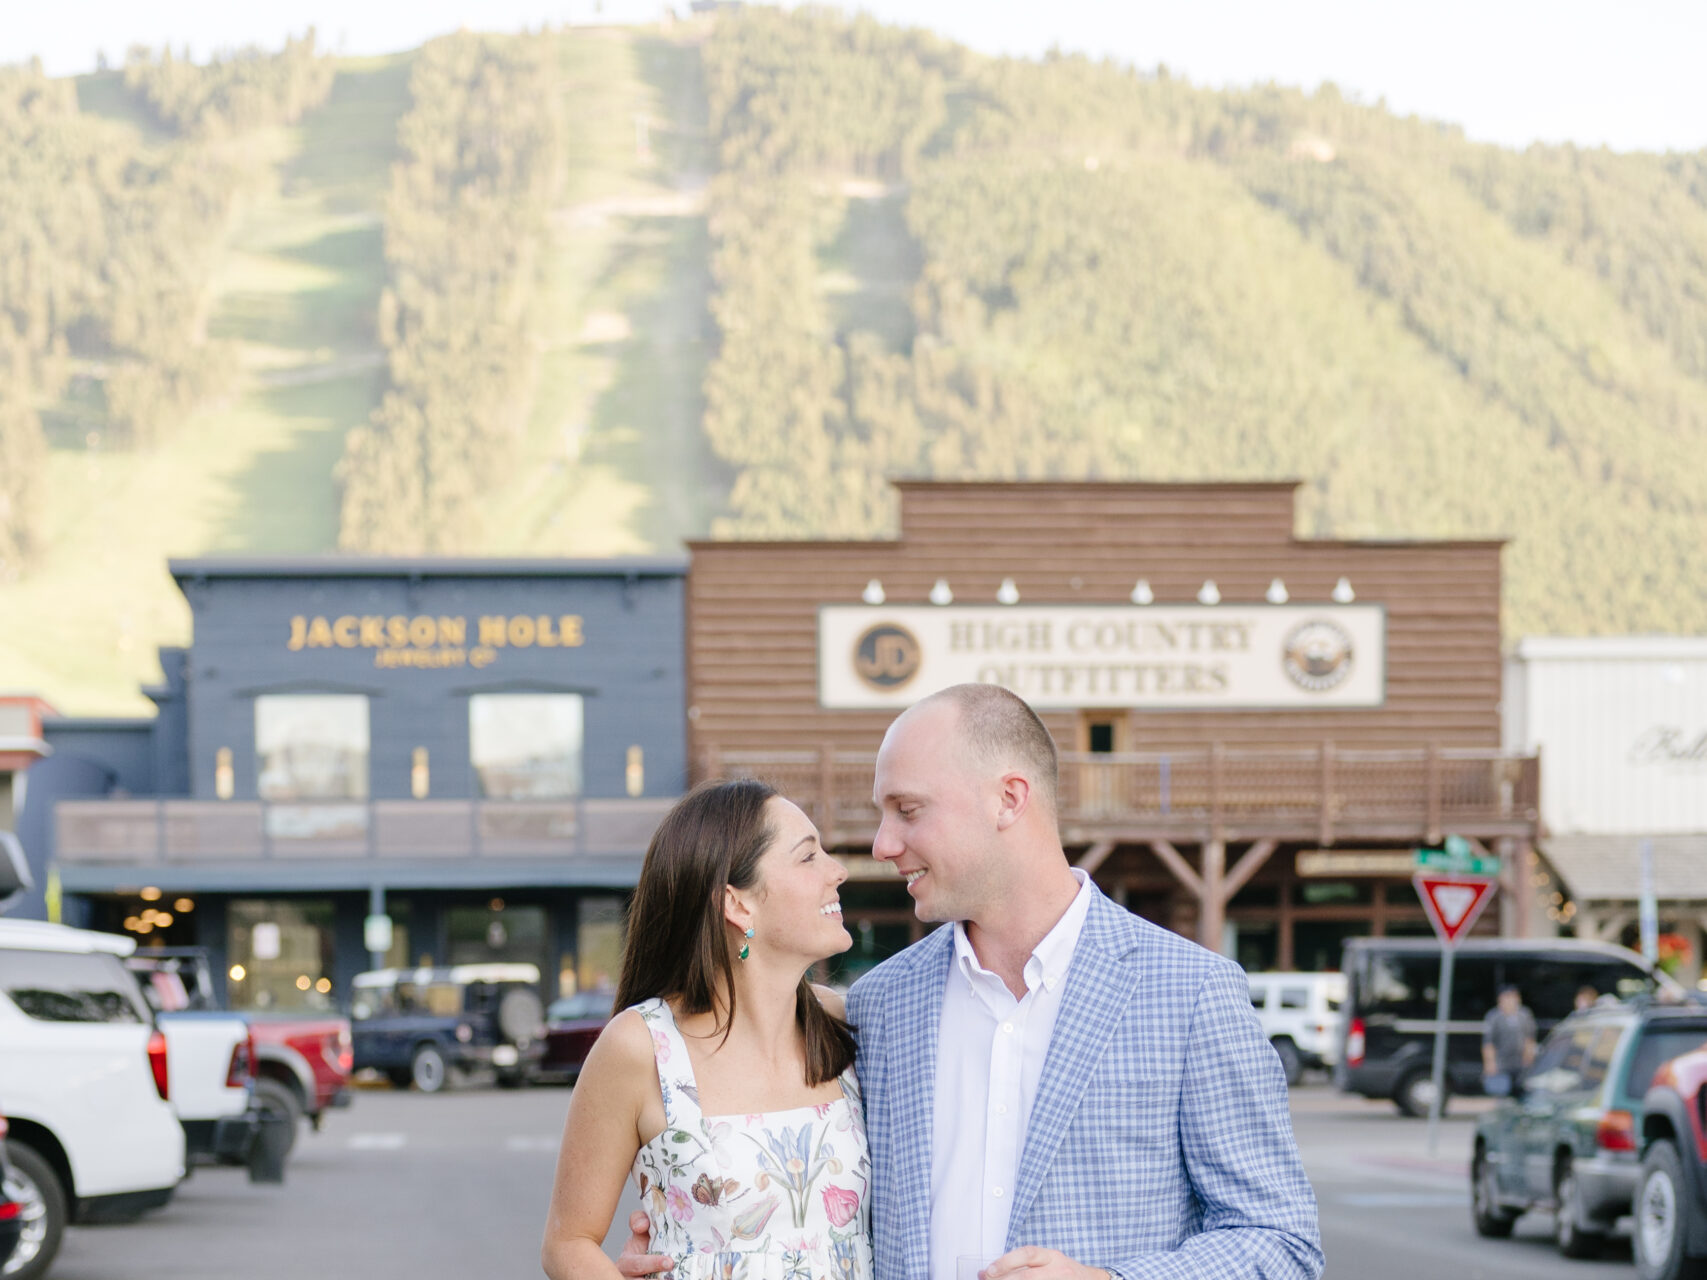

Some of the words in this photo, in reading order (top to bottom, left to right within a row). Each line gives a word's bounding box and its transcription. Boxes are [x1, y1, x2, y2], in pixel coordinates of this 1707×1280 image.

[287, 615, 467, 650] JACKSON
[478, 615, 585, 648] HOLE
[948, 619, 1053, 652] HIGH
[1065, 619, 1257, 652] COUNTRY
[976, 662, 1228, 694] OUTFITTERS
